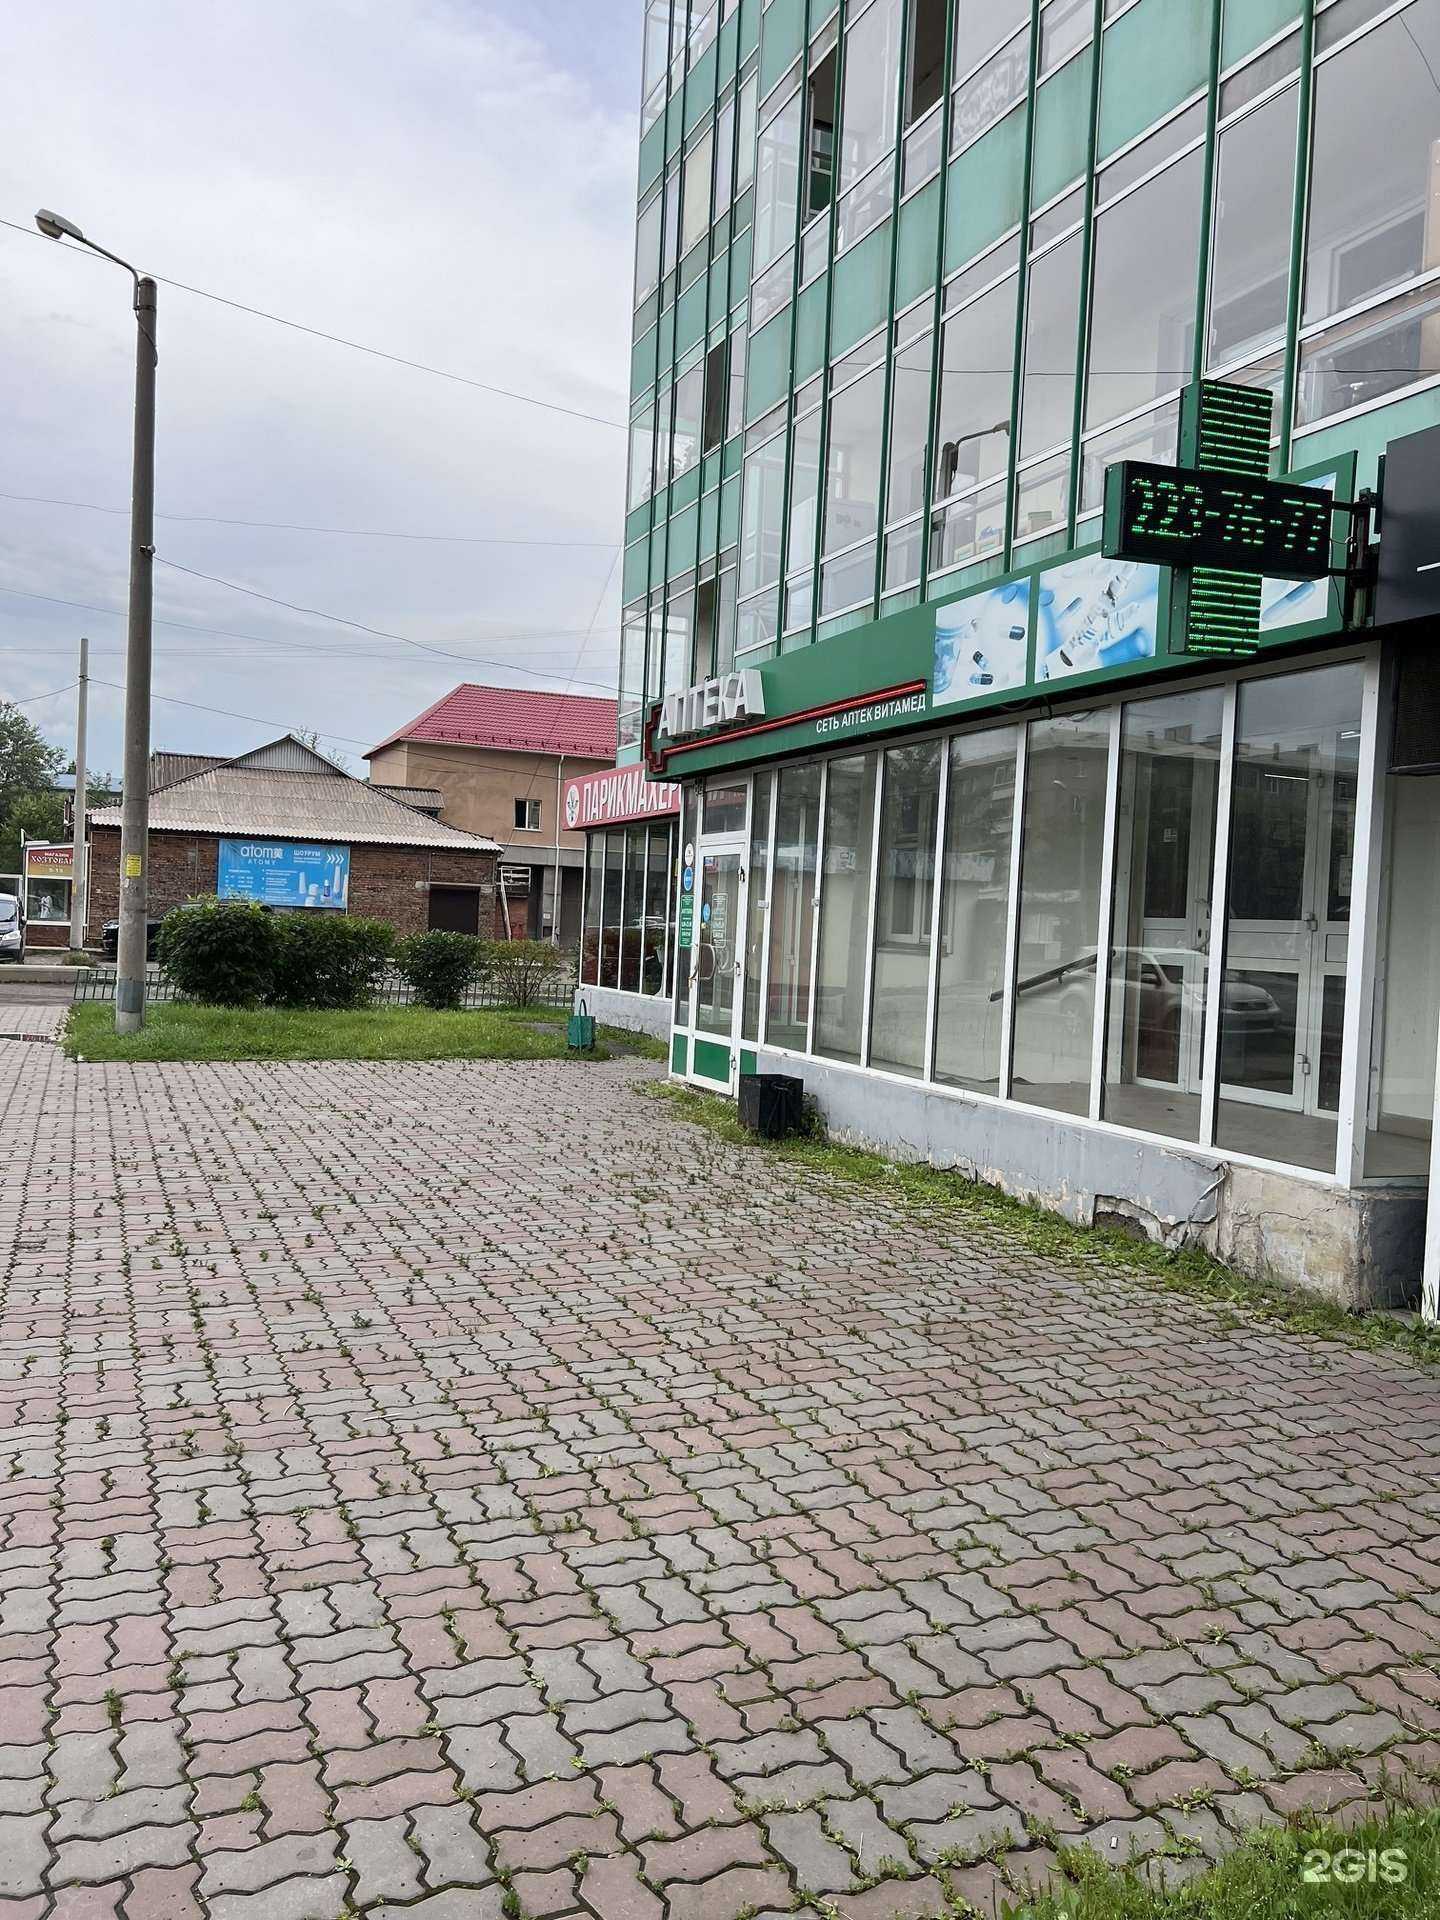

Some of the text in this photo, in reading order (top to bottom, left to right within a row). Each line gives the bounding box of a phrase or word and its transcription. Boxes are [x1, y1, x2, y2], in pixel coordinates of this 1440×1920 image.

[657, 668, 765, 739] АПТЕКА
[816, 694, 926, 734] СЕТЬ АПТЕК ВИТАМЕД
[582, 769, 681, 824] ПАРИКМАХЕР
